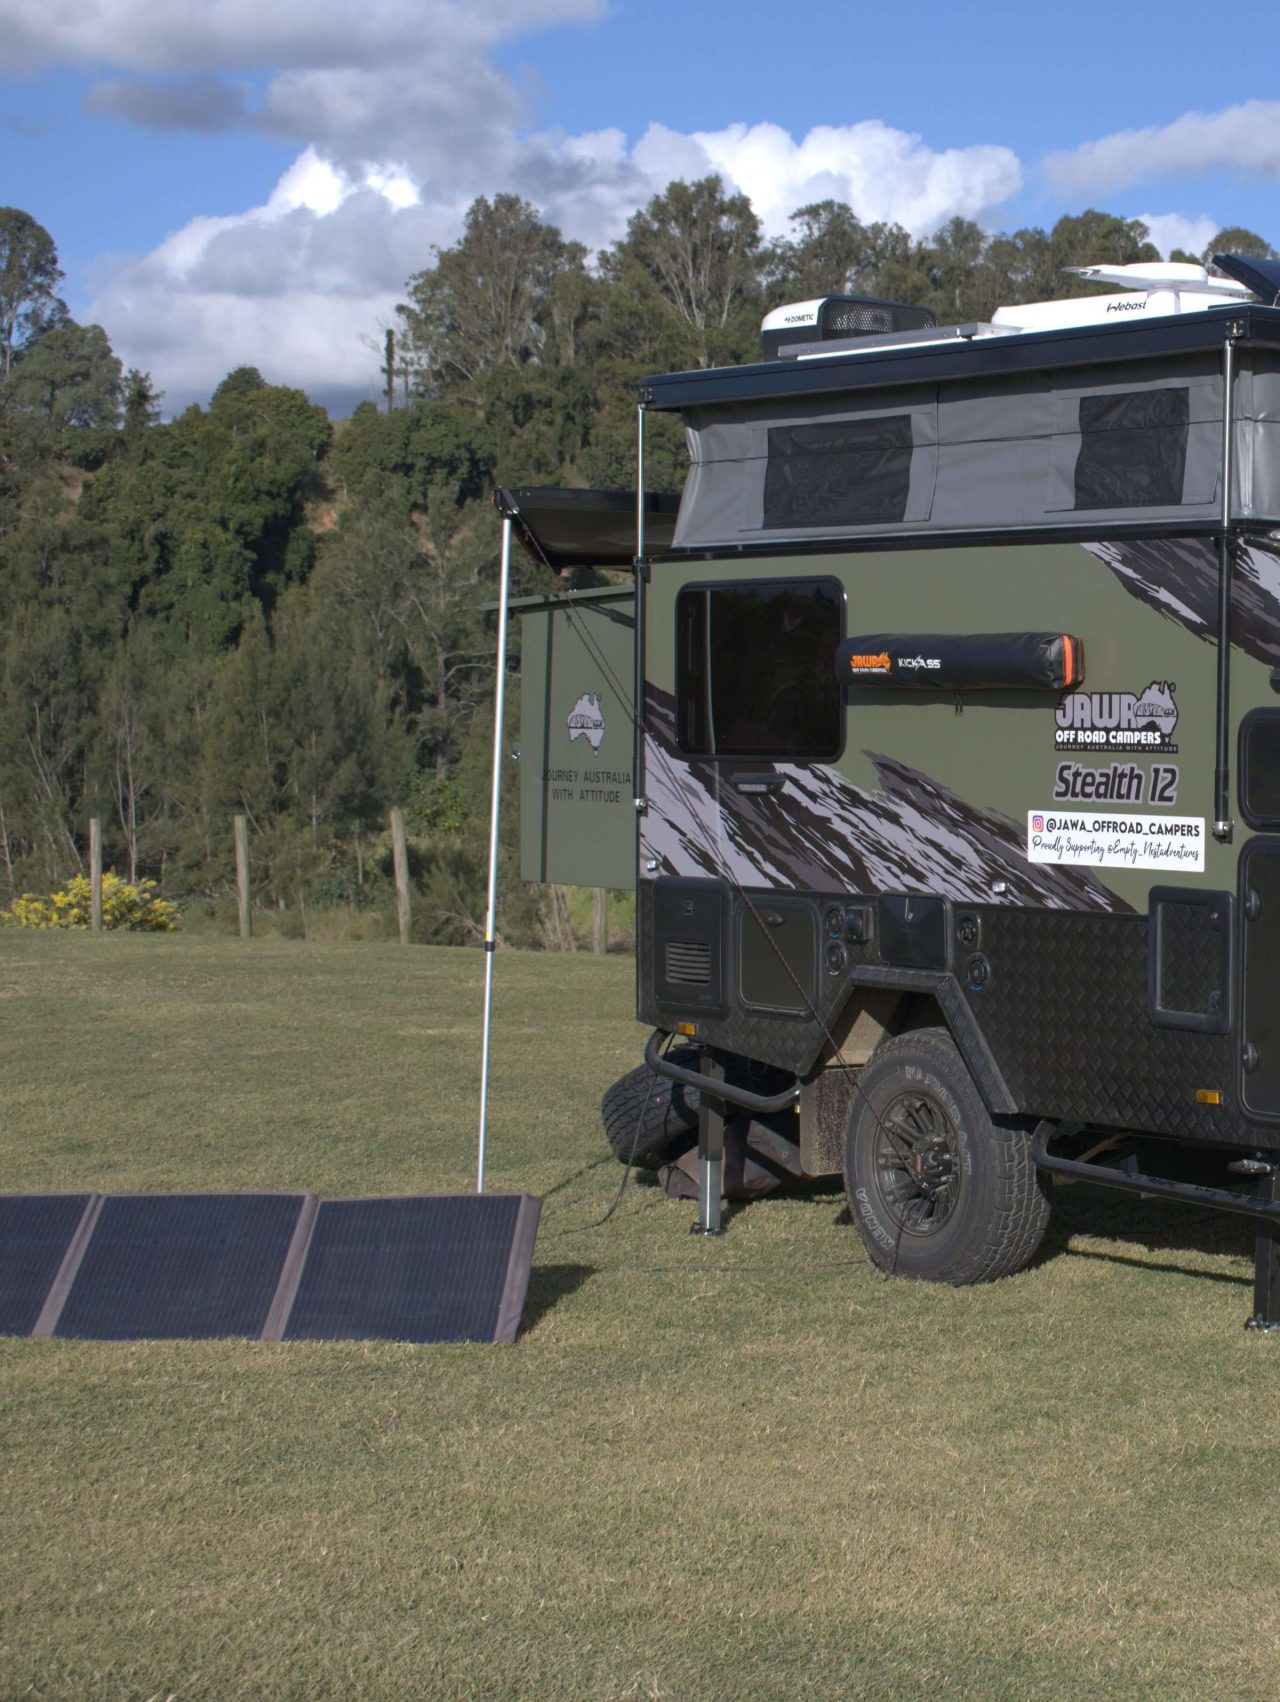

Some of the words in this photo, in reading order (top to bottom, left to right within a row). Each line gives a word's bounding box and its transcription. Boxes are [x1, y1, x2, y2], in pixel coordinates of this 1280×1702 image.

[1106, 300, 1147, 313] Webast
[791, 314, 814, 323] DOMETIC
[898, 656, 941, 670] KICKASS
[1055, 730, 1076, 743] OFF
[1077, 731, 1107, 743] ROAD
[1109, 731, 1161, 745] CAMPERS
[583, 771, 632, 784] AUSTRALIA
[1055, 763, 1144, 801] Stealth
[1149, 766, 1178, 803] 12
[552, 788, 573, 801] WITH
[580, 790, 621, 803] ATTITUDE
[1046, 817, 1200, 838] @JAWA_OFFROAD_CAMPERS
[1032, 835, 1064, 860] Proudly
[1065, 836, 1106, 863] Supporting
[856, 1187, 896, 1250] KENDA
